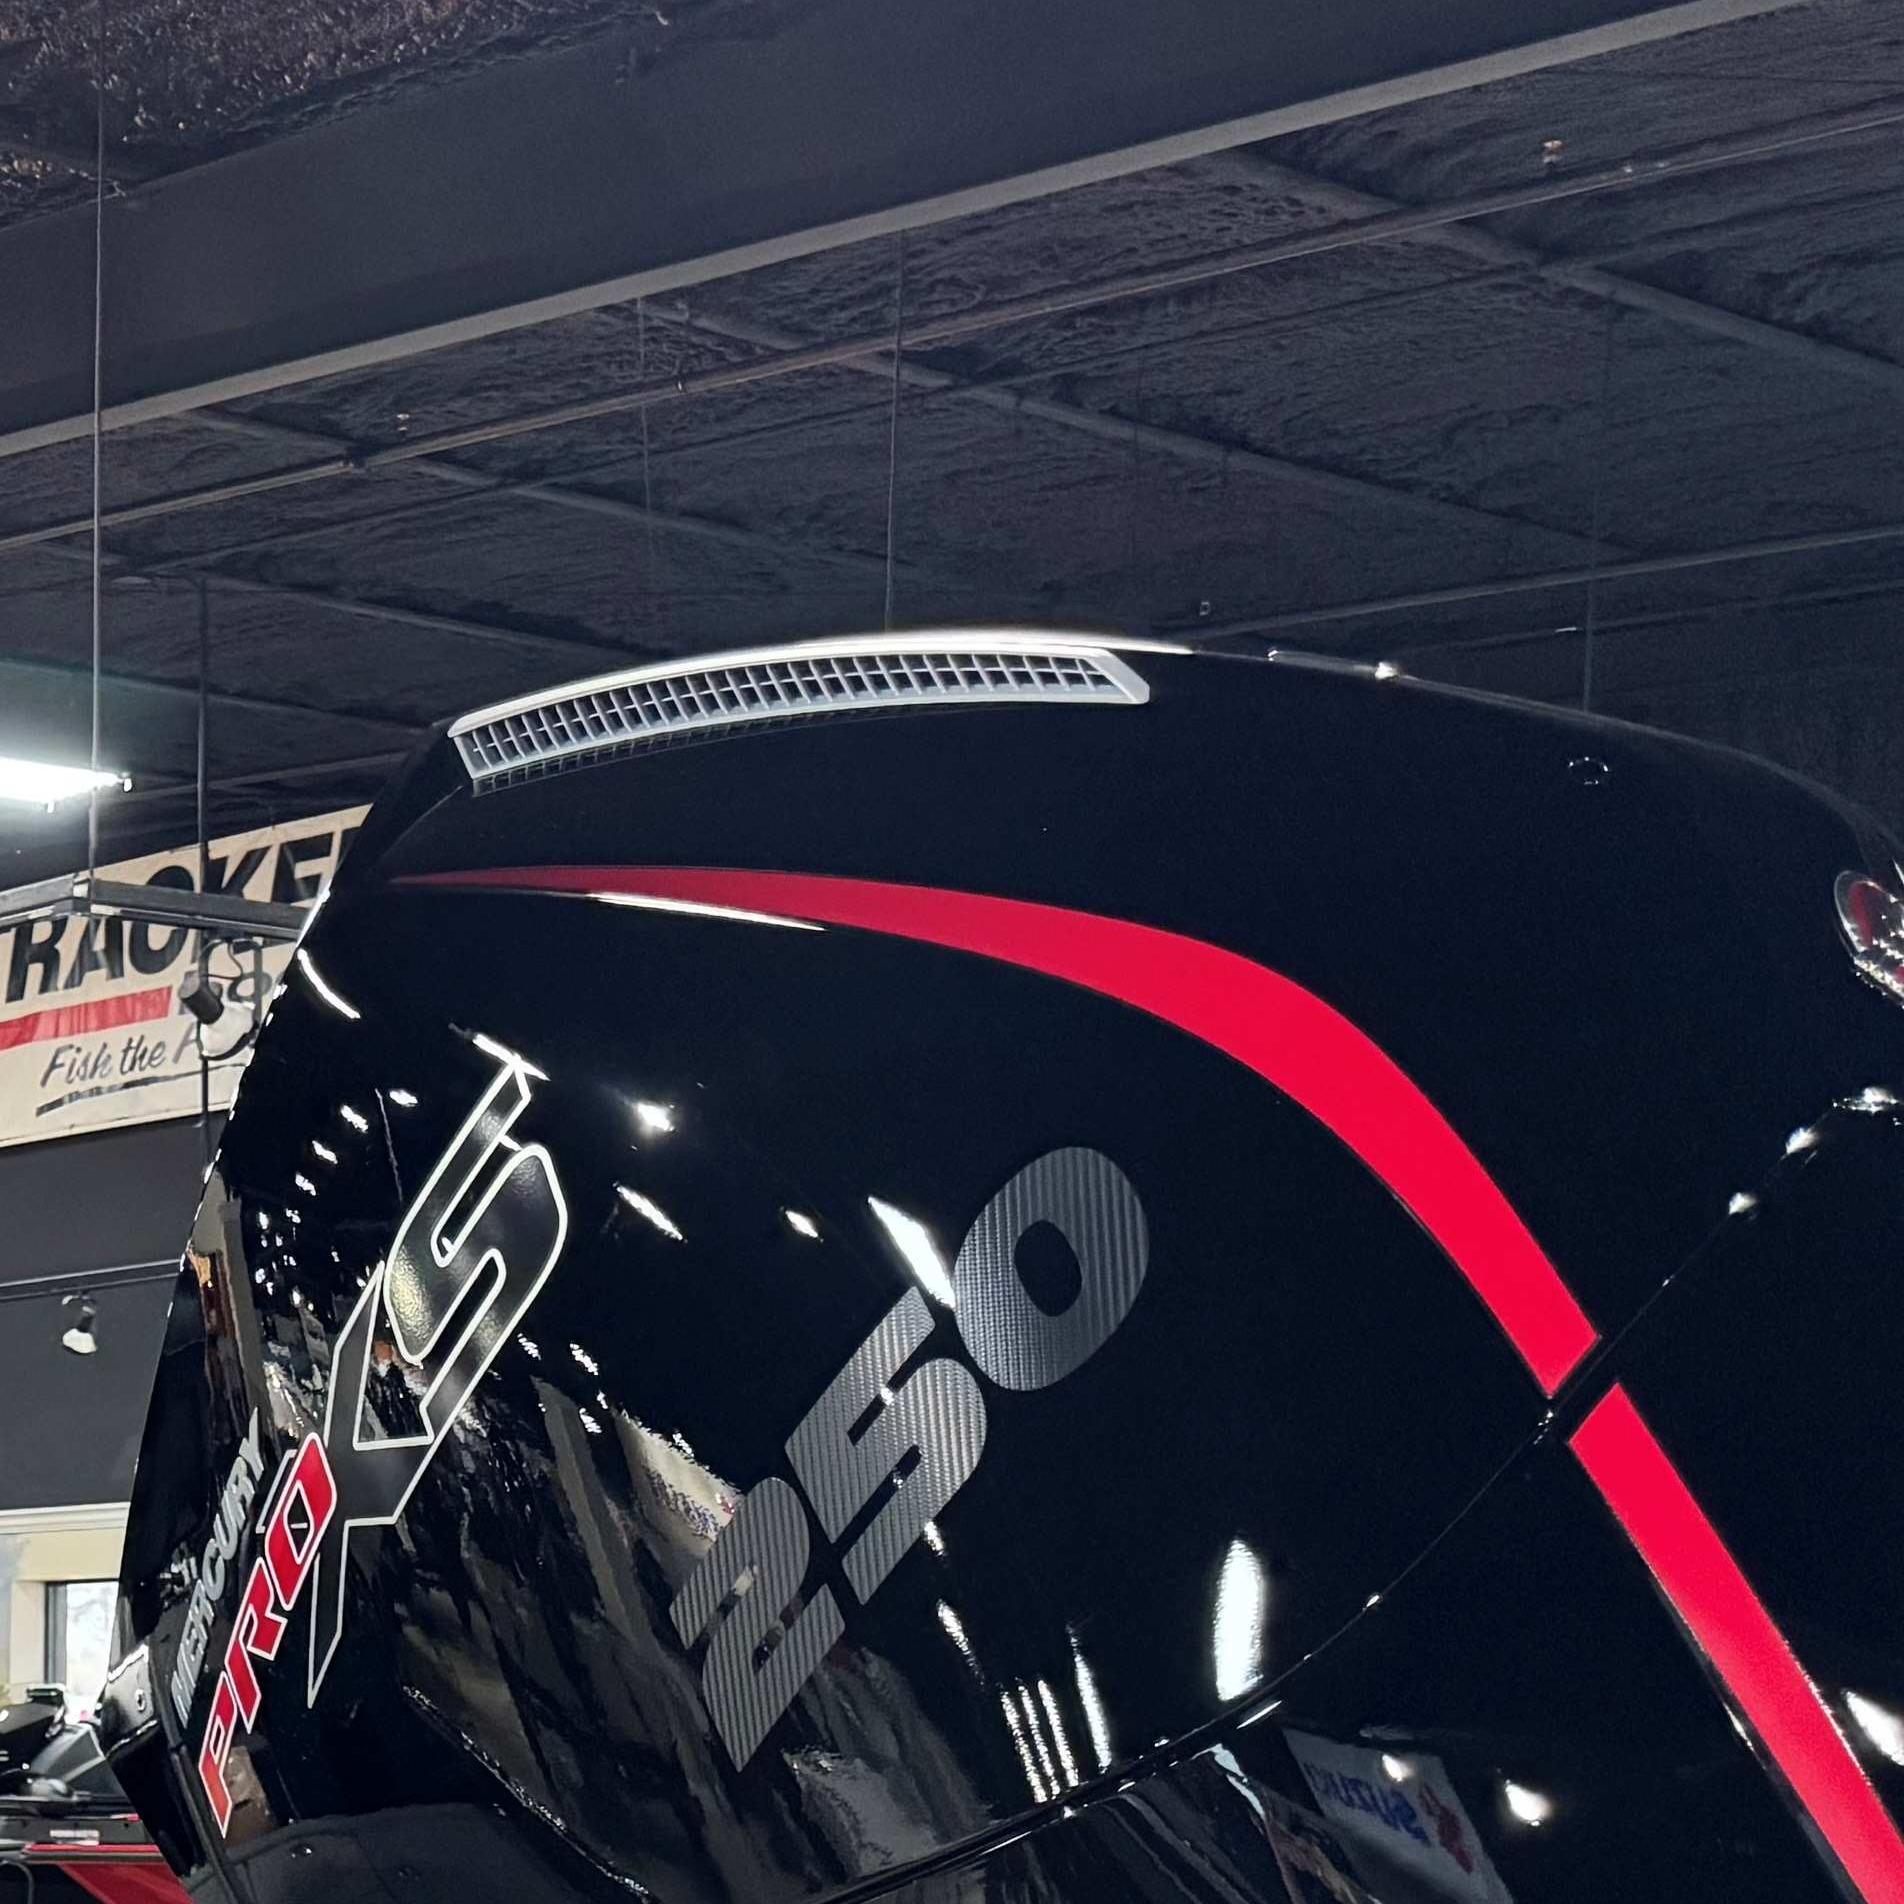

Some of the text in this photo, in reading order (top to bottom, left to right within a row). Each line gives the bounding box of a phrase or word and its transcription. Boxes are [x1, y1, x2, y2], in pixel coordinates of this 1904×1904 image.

[40, 1044, 114, 1089] Fish
[119, 1035, 165, 1074] the
[172, 1406, 264, 1729] MERCURY
[669, 1146, 1150, 1772] 250
